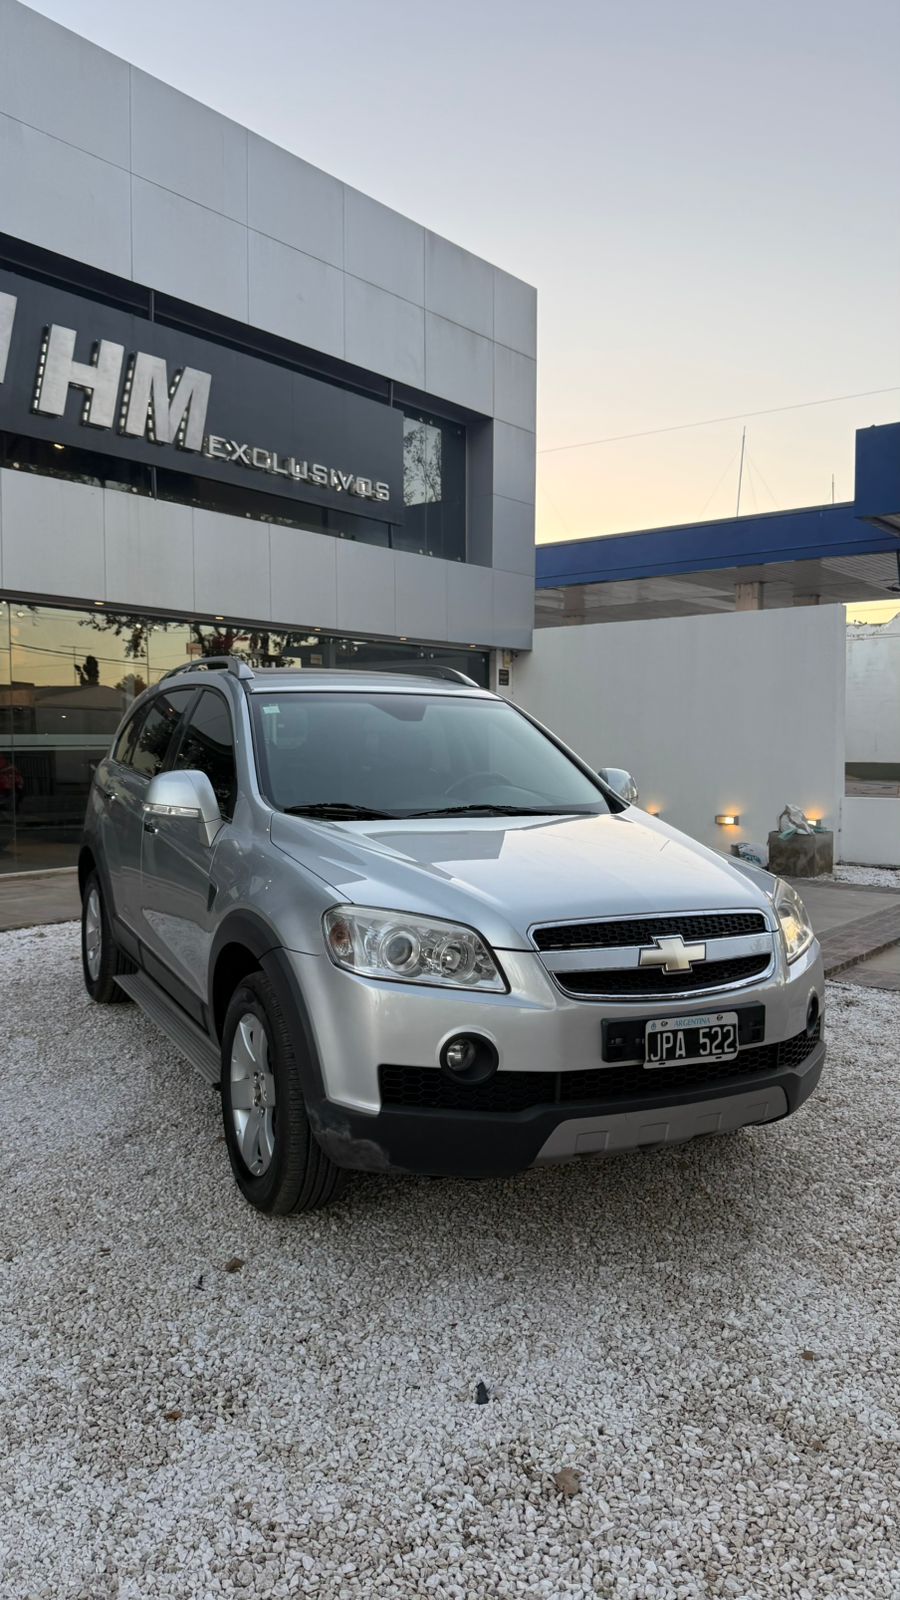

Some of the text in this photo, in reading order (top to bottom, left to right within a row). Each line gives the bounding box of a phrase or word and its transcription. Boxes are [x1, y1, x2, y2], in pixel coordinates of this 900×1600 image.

[35, 323, 212, 452] HM
[204, 434, 390, 501] EXCLUSIVOS
[651, 1026, 735, 1061] JPA 522
[674, 1017, 711, 1029] ARGENTINA
